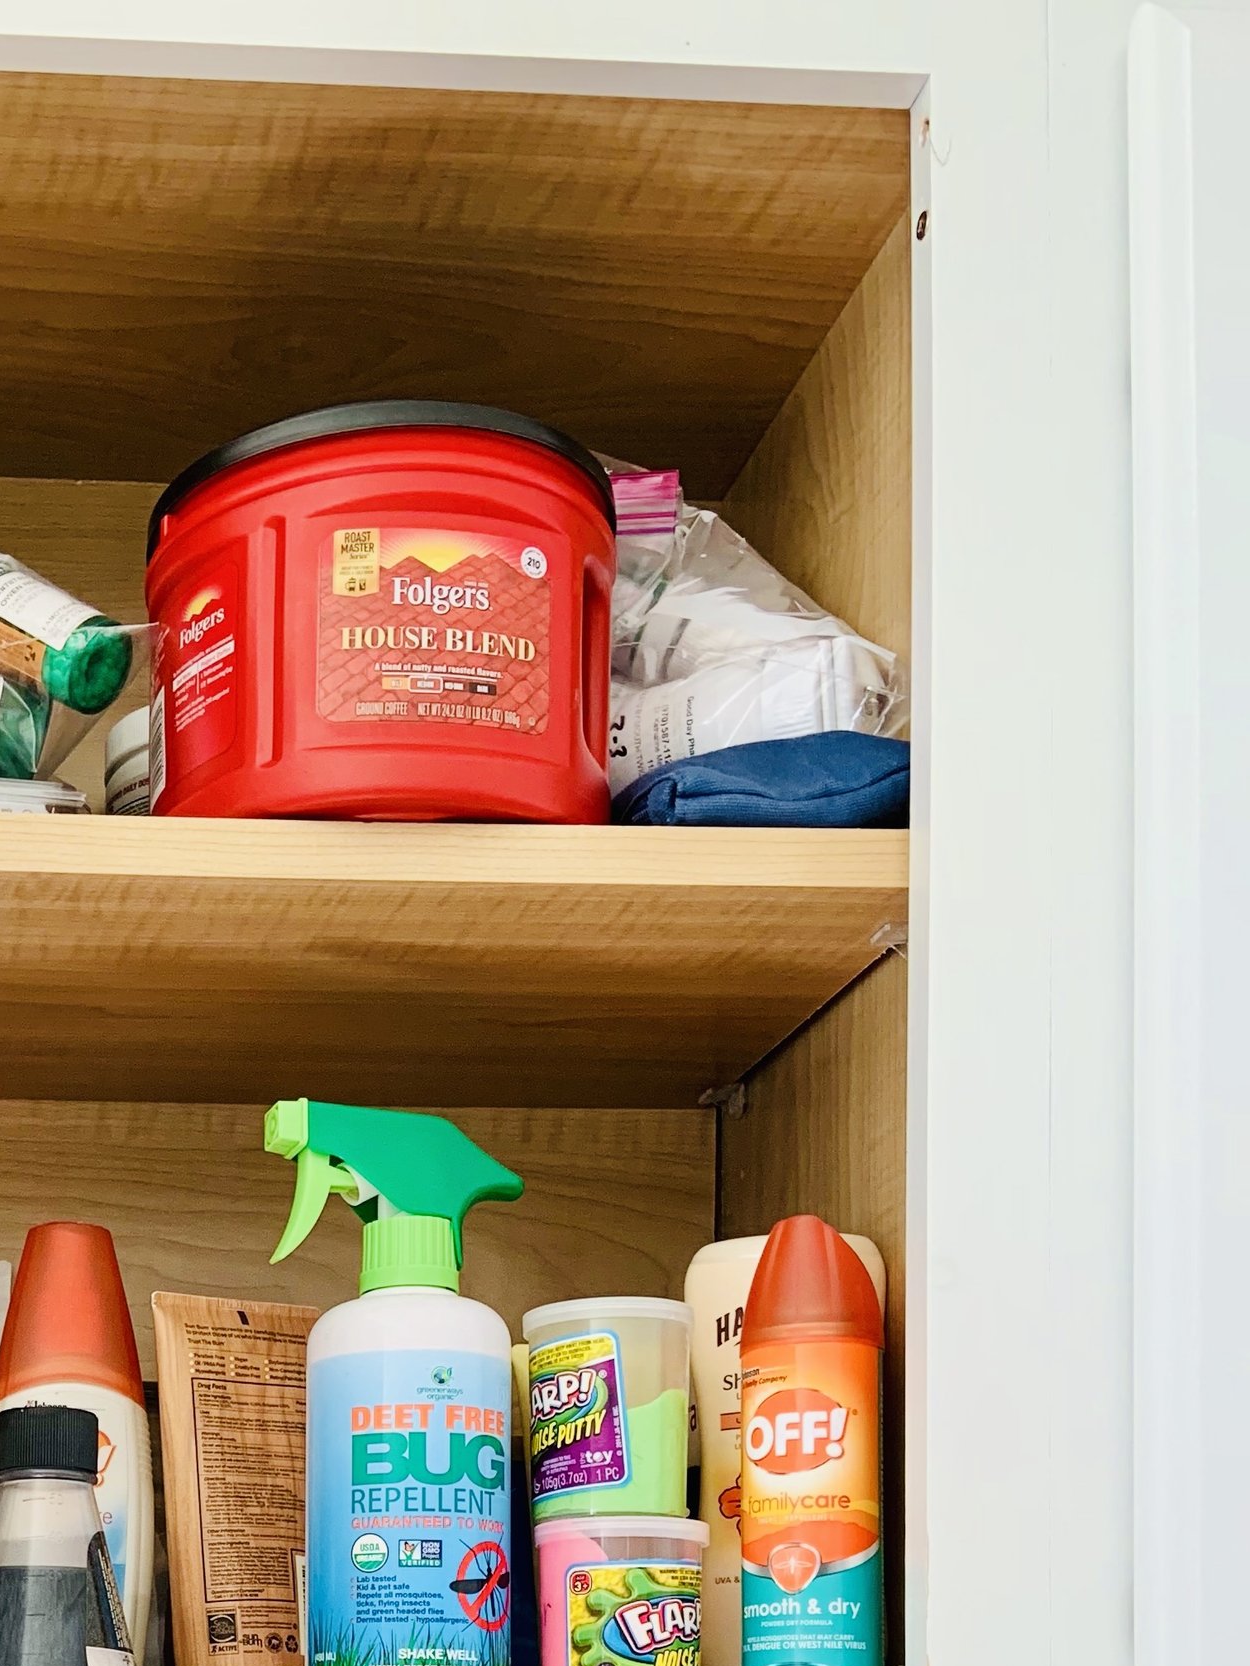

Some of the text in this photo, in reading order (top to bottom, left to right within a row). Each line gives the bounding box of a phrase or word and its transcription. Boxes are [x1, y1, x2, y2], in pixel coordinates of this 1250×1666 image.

[344, 531, 371, 544] ROAST
[340, 543, 374, 554] MASTER
[527, 558, 540, 569] 210
[391, 577, 490, 615] Folgers
[179, 607, 225, 650] Folgers
[341, 626, 536, 662] HOUSE BLEND
[417, 1386, 463, 1395] greenerways
[427, 1392, 454, 1400] organic
[352, 1404, 504, 1435] DEET FREE
[557, 1409, 607, 1448] PUTTY
[746, 1407, 849, 1461] OFF!
[352, 1432, 505, 1490] BUG
[352, 1487, 495, 1516] REPELLENT
[748, 1491, 851, 1516] familycare
[352, 1516, 505, 1534] GUARANTEED TO WORK
[360, 1543, 380, 1552] USDA
[378, 1584, 391, 1592] pet
[575, 1581, 589, 1592] 3+
[356, 1592, 382, 1600] Repels
[395, 1592, 444, 1600] mosquitoes,
[744, 1597, 860, 1619] smooth & dry
[752, 1641, 866, 1651] DENGUE OR WEST NILE VIRUS
[399, 1649, 478, 1661] SHAKE WELL
